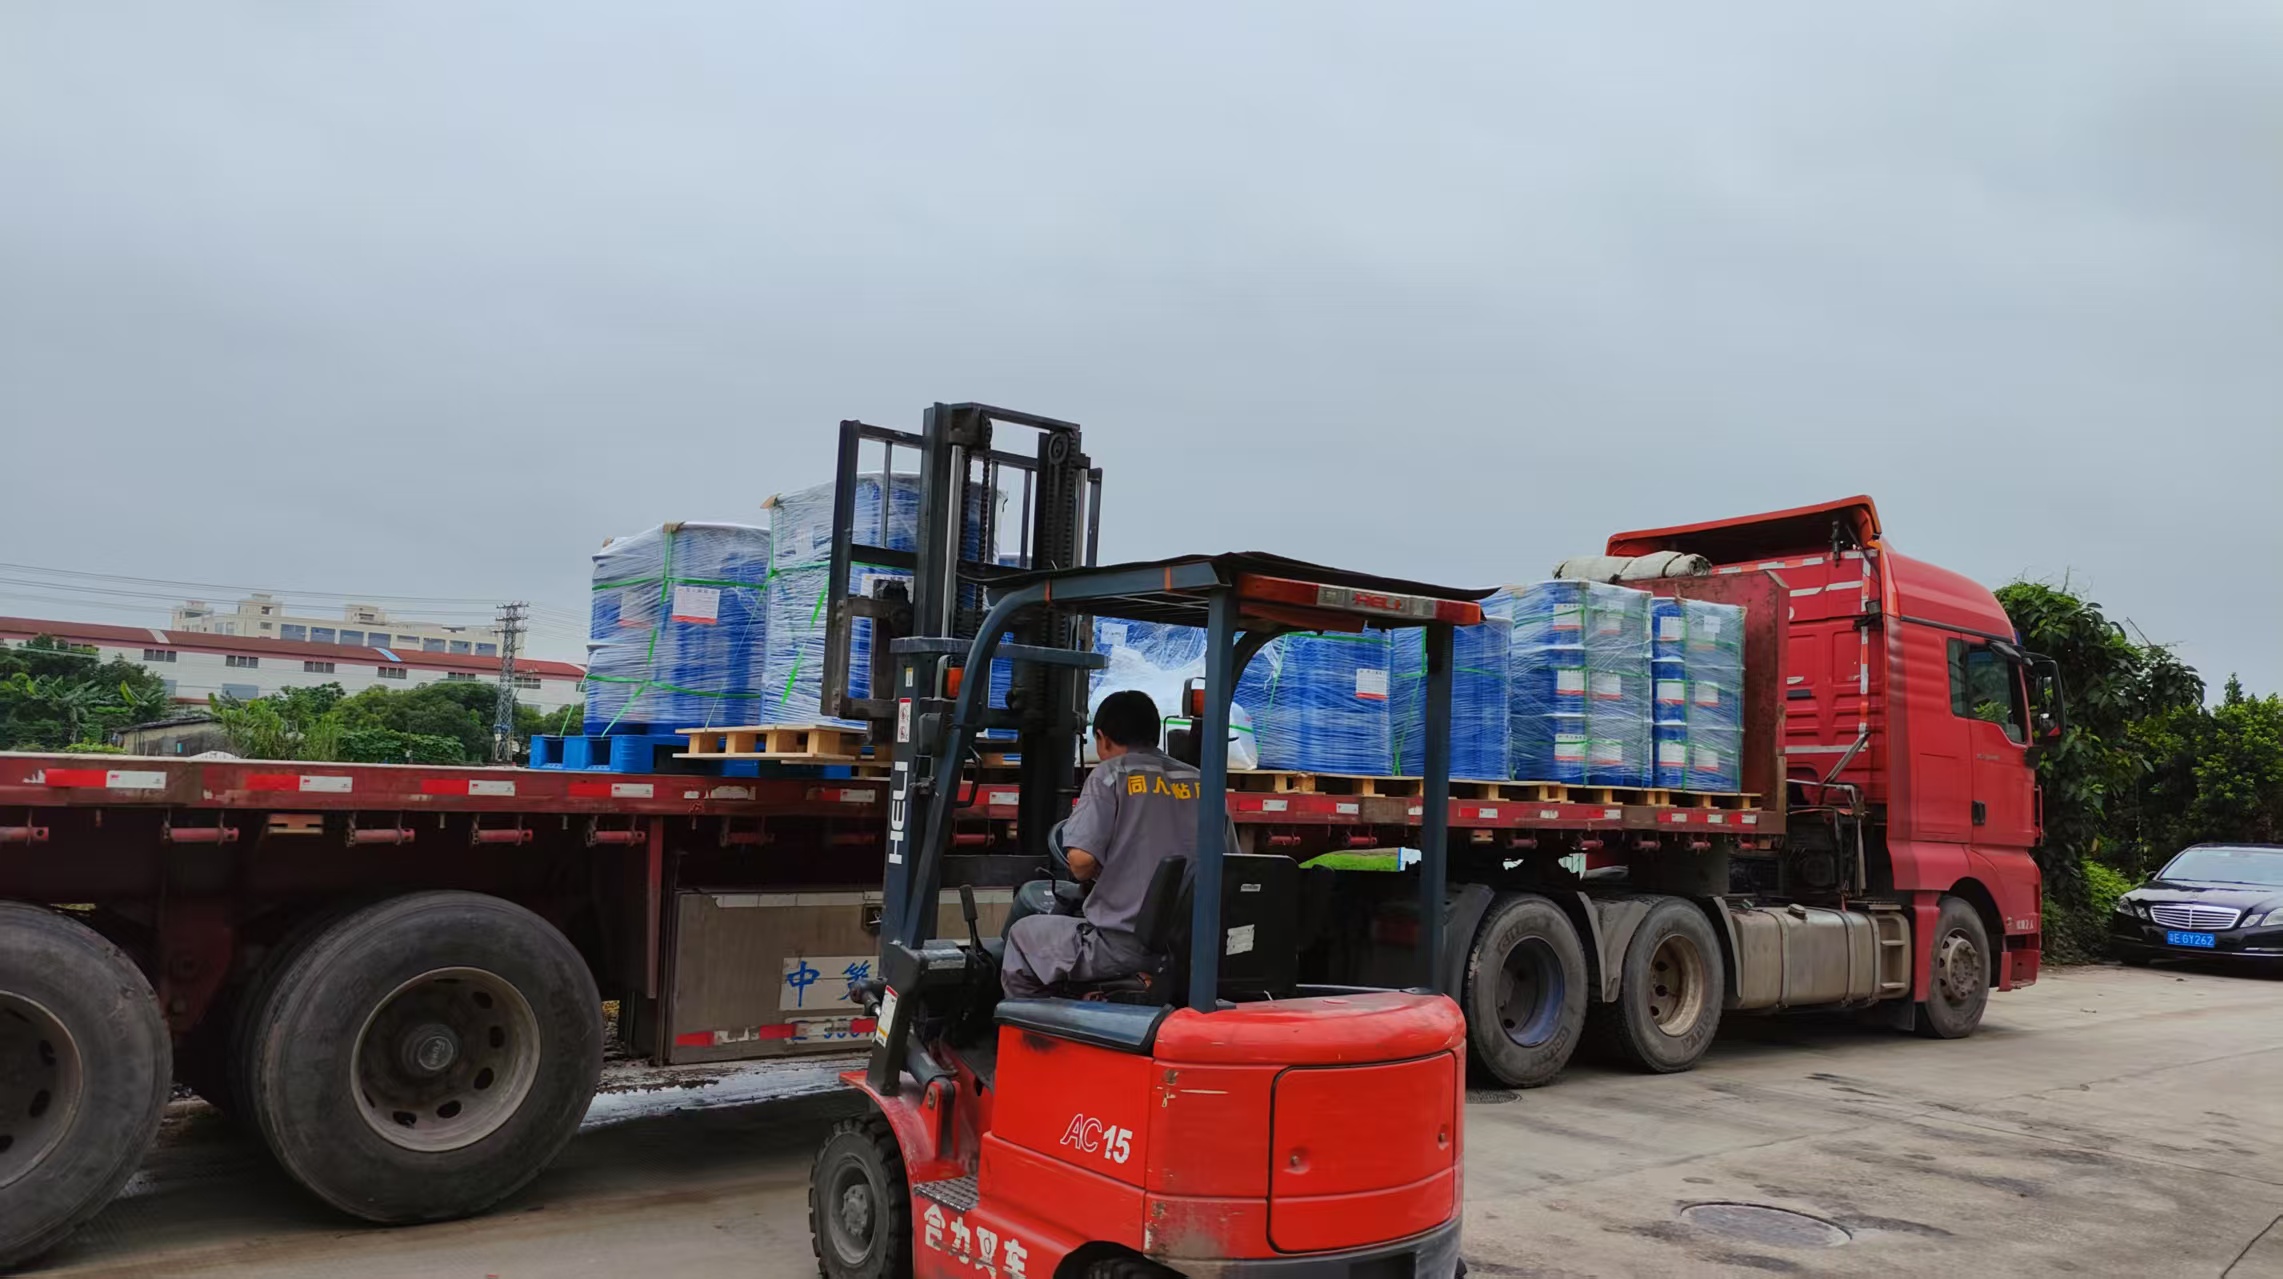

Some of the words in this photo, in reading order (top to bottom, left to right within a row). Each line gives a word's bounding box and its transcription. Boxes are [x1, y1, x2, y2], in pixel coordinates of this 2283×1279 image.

[888, 761, 908, 864] HELI
[924, 1203, 1028, 1279] 合力叉车
